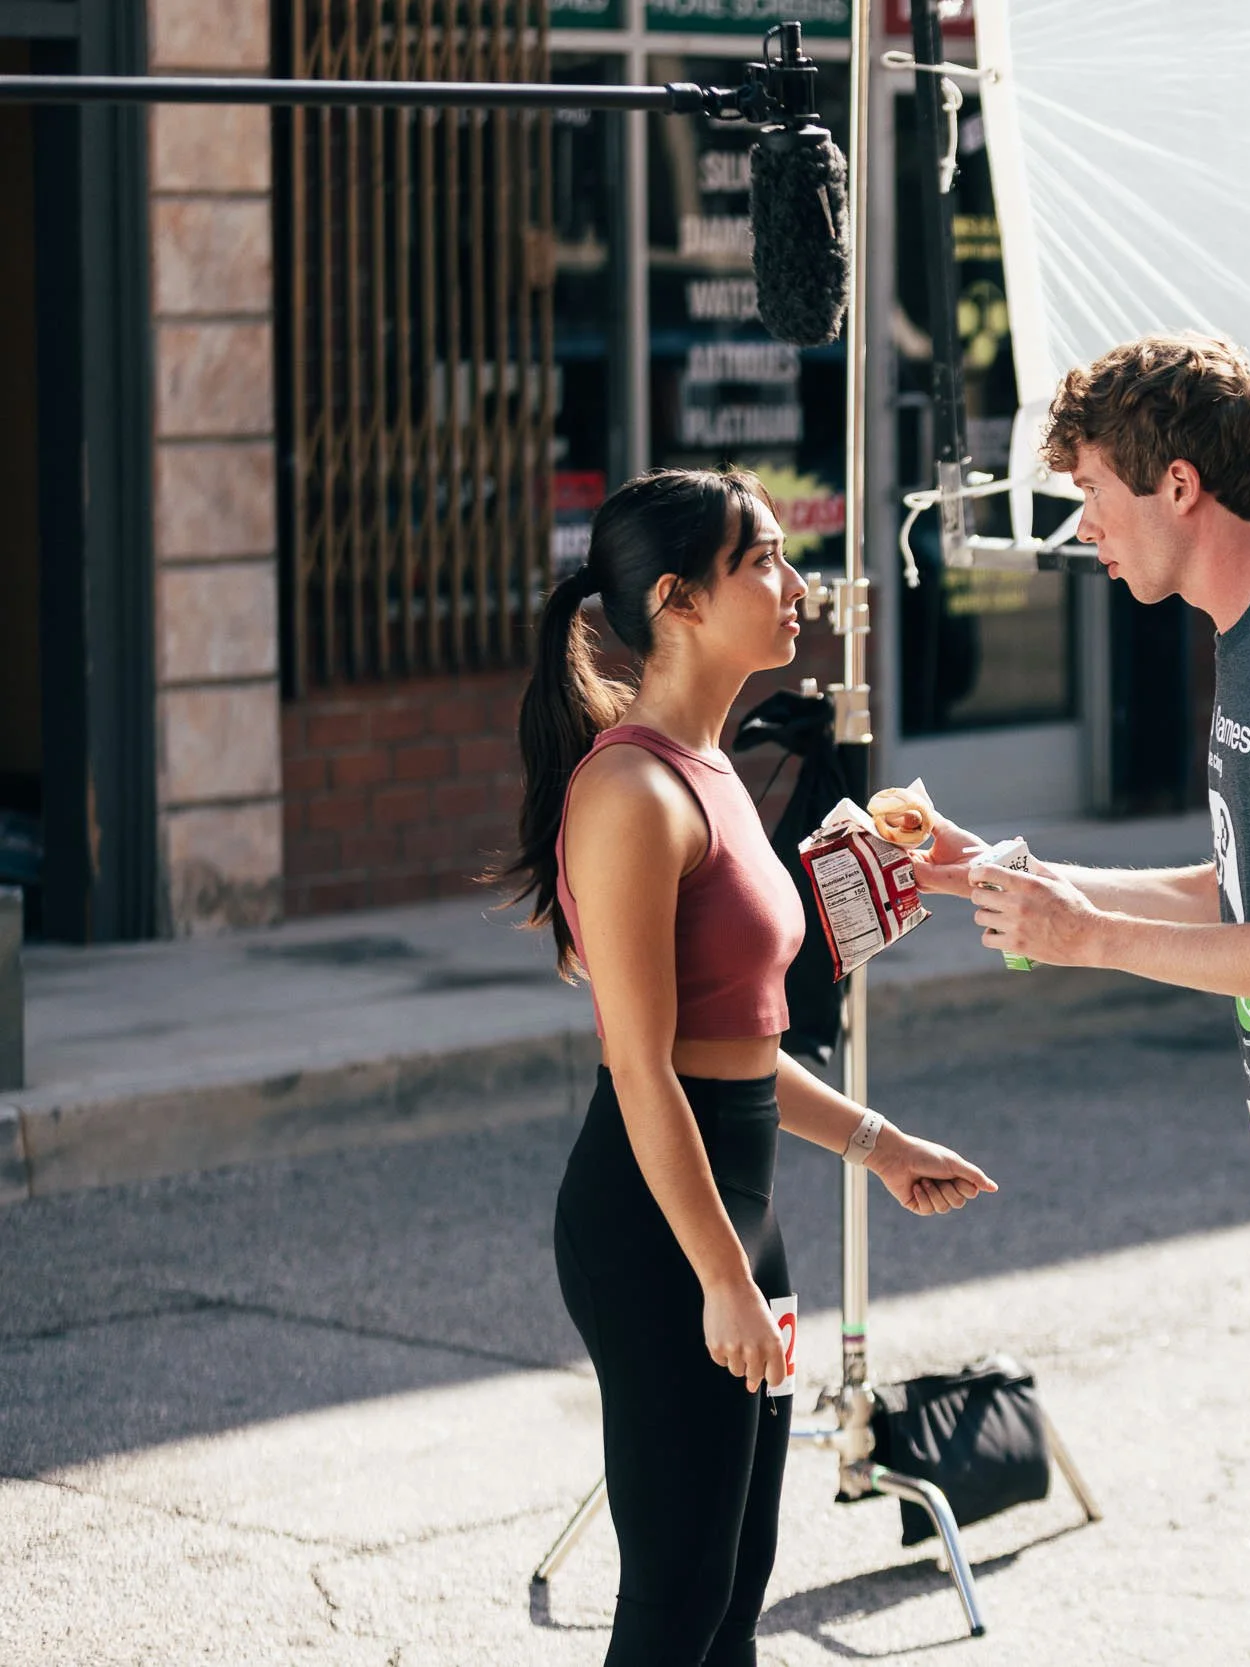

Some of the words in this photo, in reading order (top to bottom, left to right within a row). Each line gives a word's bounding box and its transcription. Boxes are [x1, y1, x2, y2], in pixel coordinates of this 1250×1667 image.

[821, 876, 845, 889] Nutrition
[845, 870, 860, 879] Facts
[854, 887, 866, 896] 150
[827, 897, 847, 908] Calories
